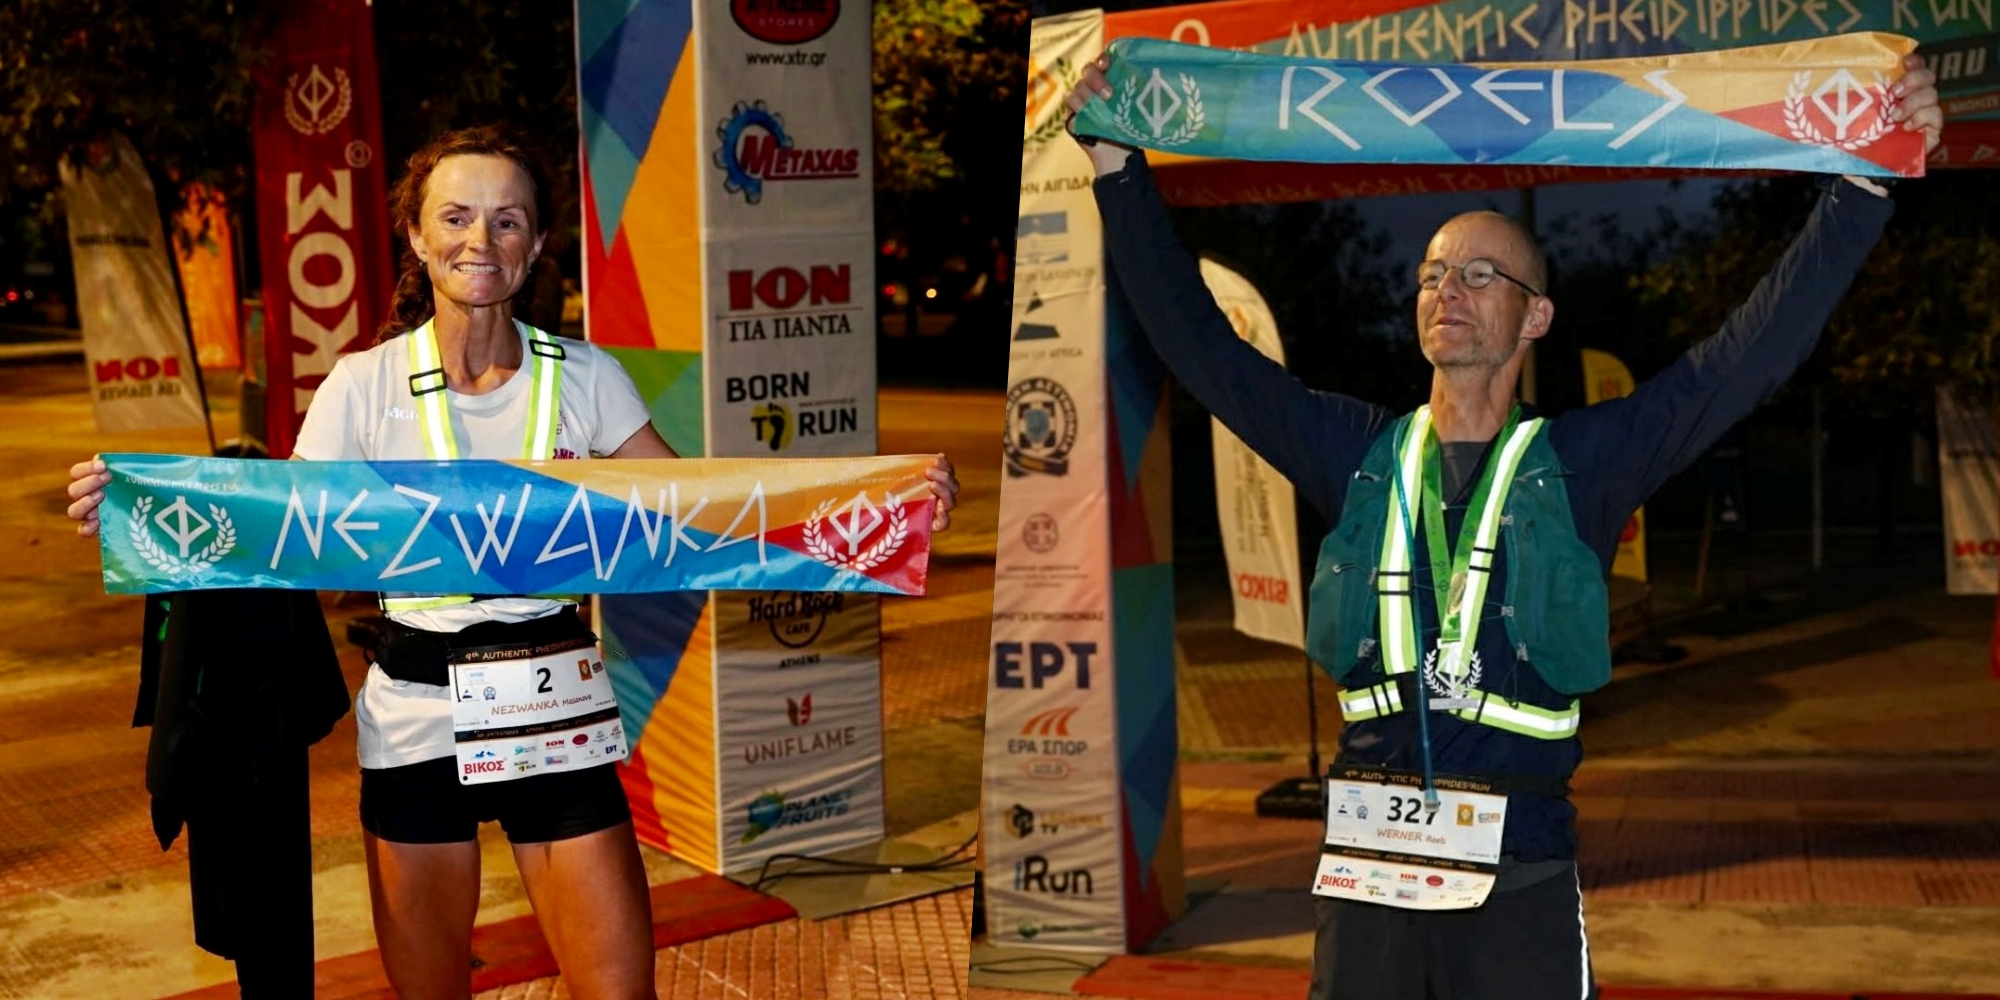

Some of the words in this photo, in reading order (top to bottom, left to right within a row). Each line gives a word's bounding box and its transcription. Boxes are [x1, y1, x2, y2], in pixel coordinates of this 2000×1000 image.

[1285, 3, 1540, 62] AUTHENTIC
[746, 52, 827, 66] www.xtr.gr
[1279, 66, 1688, 150] ROELS
[740, 135, 859, 178] METAXAS
[728, 264, 851, 311] ION
[729, 319, 767, 342] ΓΙΑ
[774, 313, 852, 339] ΠΑΝΤΑ
[726, 371, 810, 403] BORN
[798, 407, 857, 438] RUN
[269, 480, 768, 581] NEZWANKA
[749, 590, 796, 623] Hard
[798, 588, 845, 620] Rock
[482, 648, 533, 661] AUTHENTIC
[778, 653, 821, 670] ATHENS
[995, 642, 1097, 689] ΕΡΤ
[536, 667, 553, 694] 2
[491, 699, 559, 716] NEZWANKA
[744, 726, 857, 764] UNIFLAME
[464, 760, 505, 775] ΒΙΚΟΣ
[776, 802, 850, 829] FRUITS
[1041, 823, 1059, 835] TV
[1377, 828, 1423, 842] WERNER
[1320, 875, 1358, 890] ΒΙΚΟΣ
